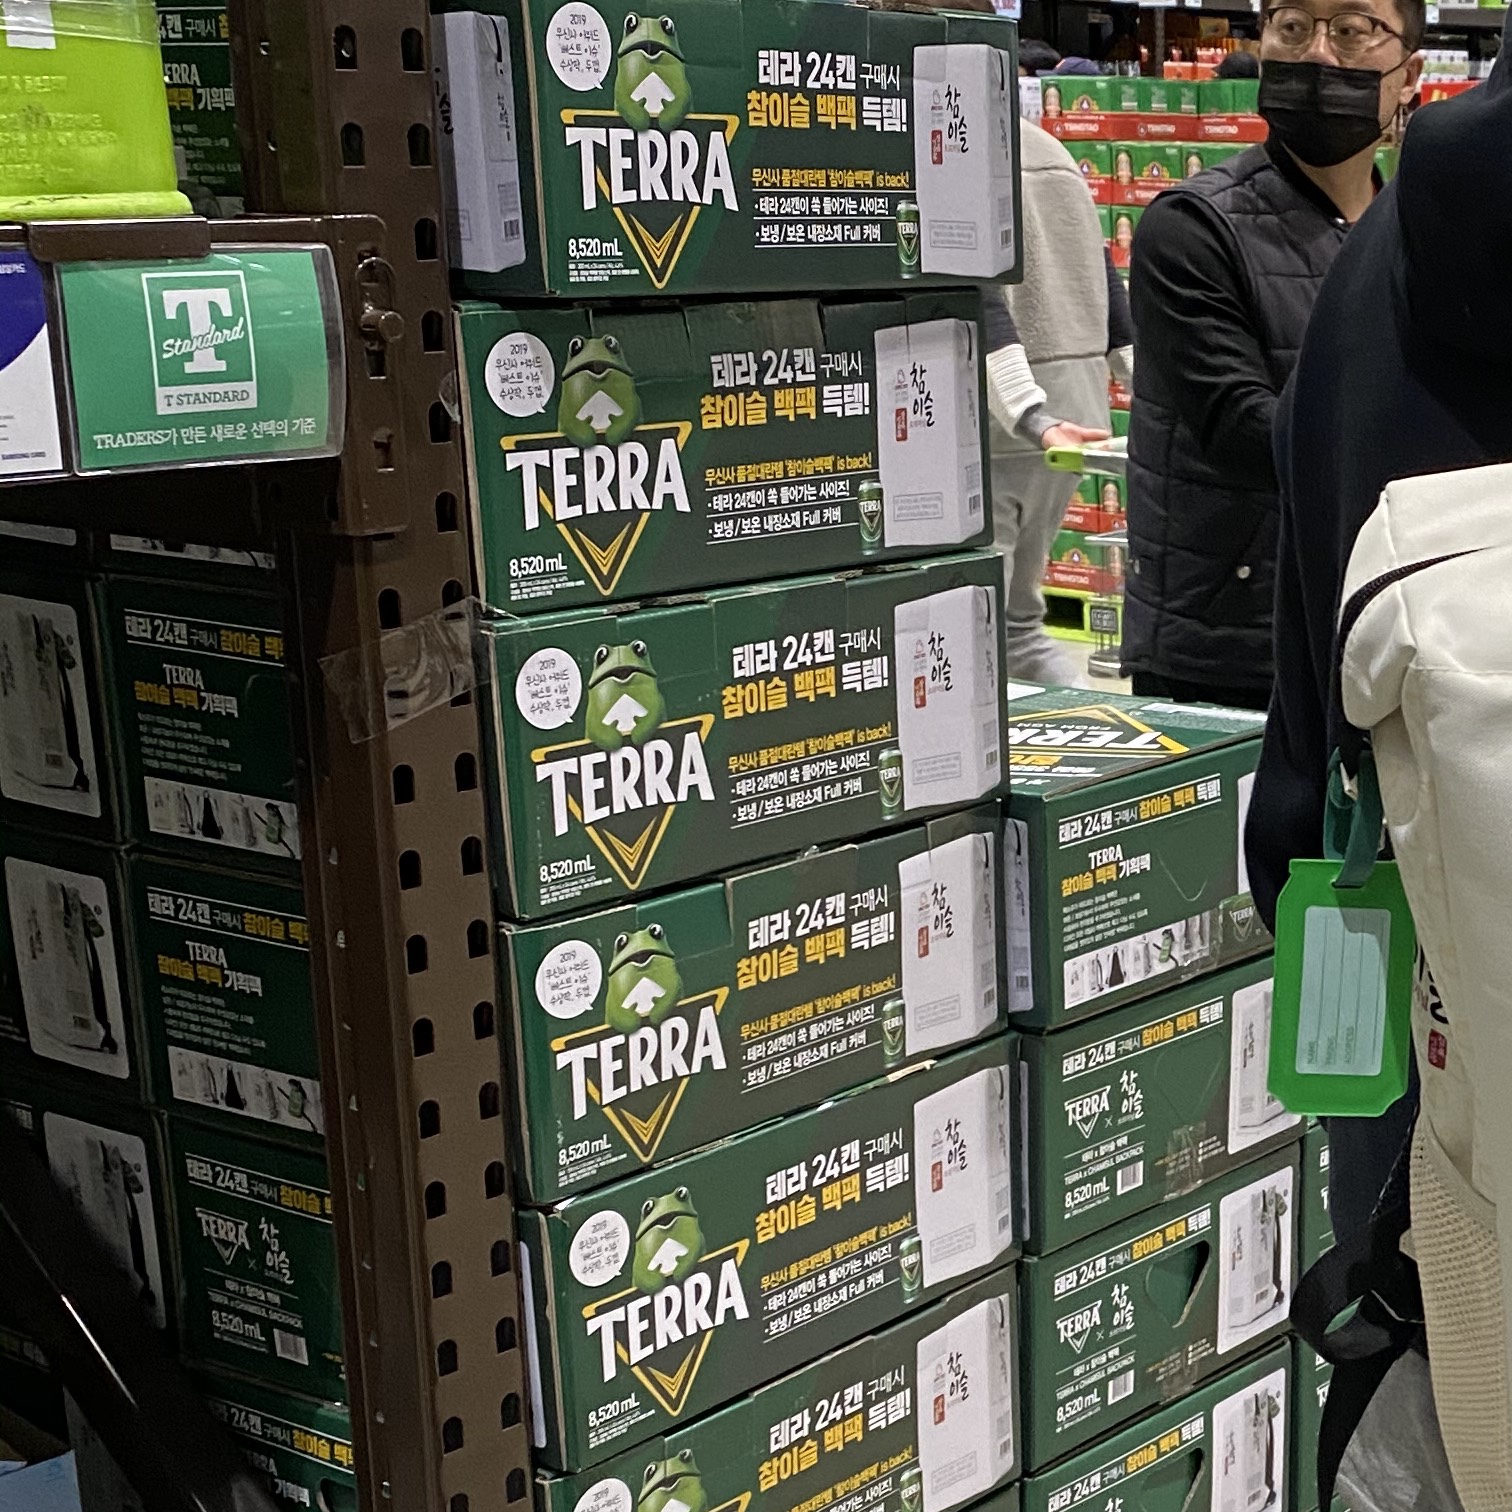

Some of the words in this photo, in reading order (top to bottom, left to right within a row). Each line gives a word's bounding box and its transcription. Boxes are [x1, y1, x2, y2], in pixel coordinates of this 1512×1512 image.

[758, 50, 801, 86] 테라
[806, 52, 856, 89] 24캔
[859, 63, 900, 90] 구매시
[747, 91, 810, 128] 참이슬
[816, 94, 856, 129] 백팩
[862, 96, 907, 131] 득템!
[944, 83, 961, 118] 참
[947, 115, 969, 153] 이슬
[566, 127, 737, 210] TERRA
[751, 168, 780, 186] 무신사
[778, 195, 809, 215] 24캔이
[822, 197, 858, 215] 들어가는
[858, 197, 889, 215] 사이즈!
[567, 237, 601, 259] 8,520
[602, 237, 623, 256] mL
[843, 224, 860, 240] Full
[862, 224, 881, 241] 커버
[162, 317, 244, 359] Standard
[710, 351, 757, 387] 테라
[762, 347, 816, 385] 24캔
[820, 350, 862, 378] 구매시
[164, 395, 173, 406] T
[176, 390, 250, 406] STANDARD
[701, 391, 767, 429] 참이슬
[774, 386, 816, 421] 백팩
[822, 382, 869, 417] 득템!
[93, 429, 177, 449] TRADERS가
[181, 426, 207, 445] 만든
[210, 423, 247, 442] 새로운
[251, 419, 288, 439] 선택의
[292, 418, 316, 435] 기준
[506, 439, 689, 528] TERRA
[732, 640, 777, 678] 테라
[782, 629, 835, 670] 24캔
[838, 626, 880, 656] 구매시
[163, 663, 204, 690] TERRA
[722, 677, 787, 719] 참이슬
[794, 666, 836, 701] 백팩
[842, 656, 888, 692] 득템!
[536, 733, 713, 834] TERRA
[1059, 823, 1082, 843] 테라
[1084, 810, 1112, 836] 24캔
[1114, 806, 1137, 825] 구매시
[1140, 793, 1171, 819] 참이슬
[1089, 844, 1123, 869] TERRA
[1119, 853, 1150, 879] 기획팩
[748, 909, 791, 950] 테라
[795, 892, 845, 936] 24캔
[849, 884, 888, 916] 구매시
[737, 944, 798, 989] 참이슬
[805, 927, 845, 963] 백팩
[851, 911, 894, 949] 득템!
[556, 1007, 725, 1118] TERRA
[1120, 1070, 1138, 1096] 참
[1065, 1091, 1110, 1126] TERRA
[1122, 1093, 1144, 1119] 이슬
[1065, 1186, 1092, 1209] 8,520
[1093, 1177, 1110, 1197] mL
[587, 1260, 748, 1380] TERRA
[770, 1408, 810, 1453] 테라
[815, 1382, 862, 1431] 24캔
[866, 1364, 904, 1401] 구매시
[759, 1439, 817, 1491] 참이슬
